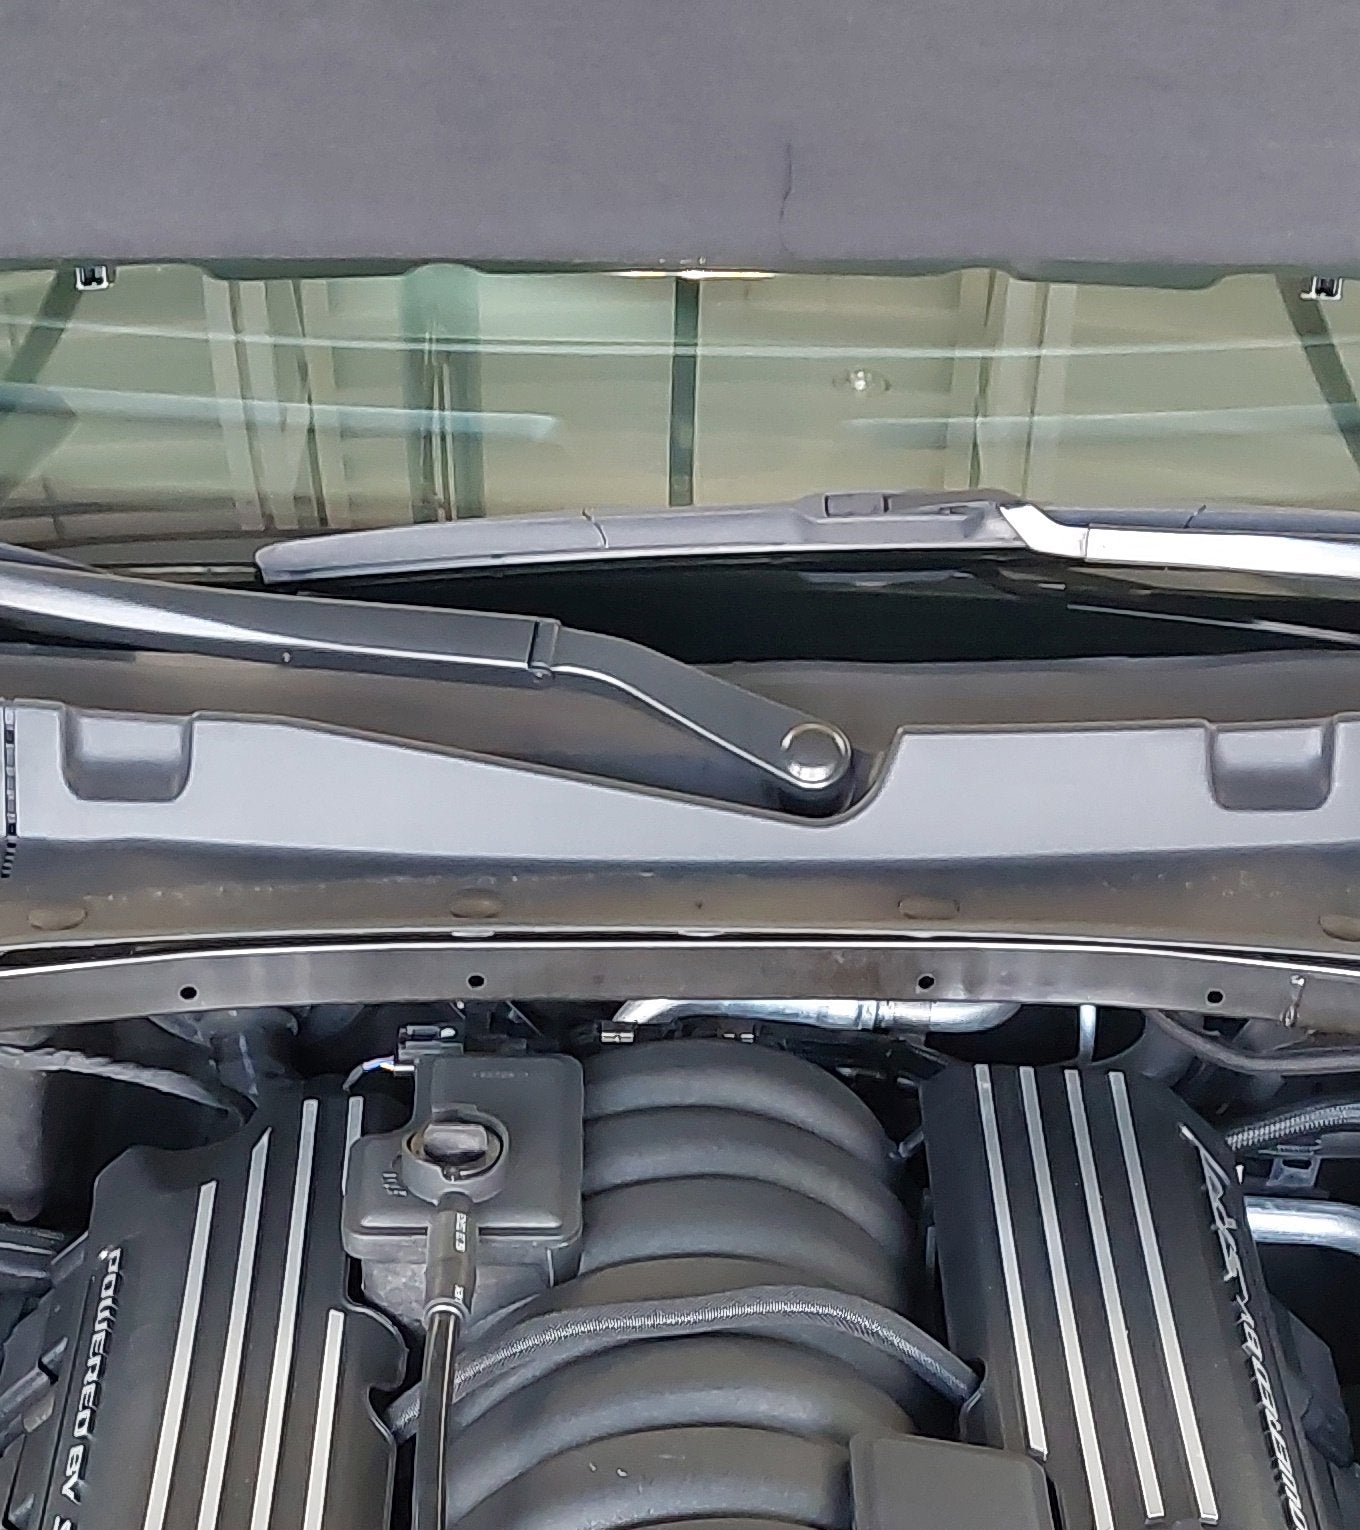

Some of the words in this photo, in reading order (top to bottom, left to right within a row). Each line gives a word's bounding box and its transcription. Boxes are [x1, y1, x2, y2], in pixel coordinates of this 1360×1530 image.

[1178, 1123, 1249, 1303] SRT
[72, 1247, 124, 1439] POWERED
[1234, 1294, 1264, 1363] BY
[60, 1444, 88, 1504] BY
